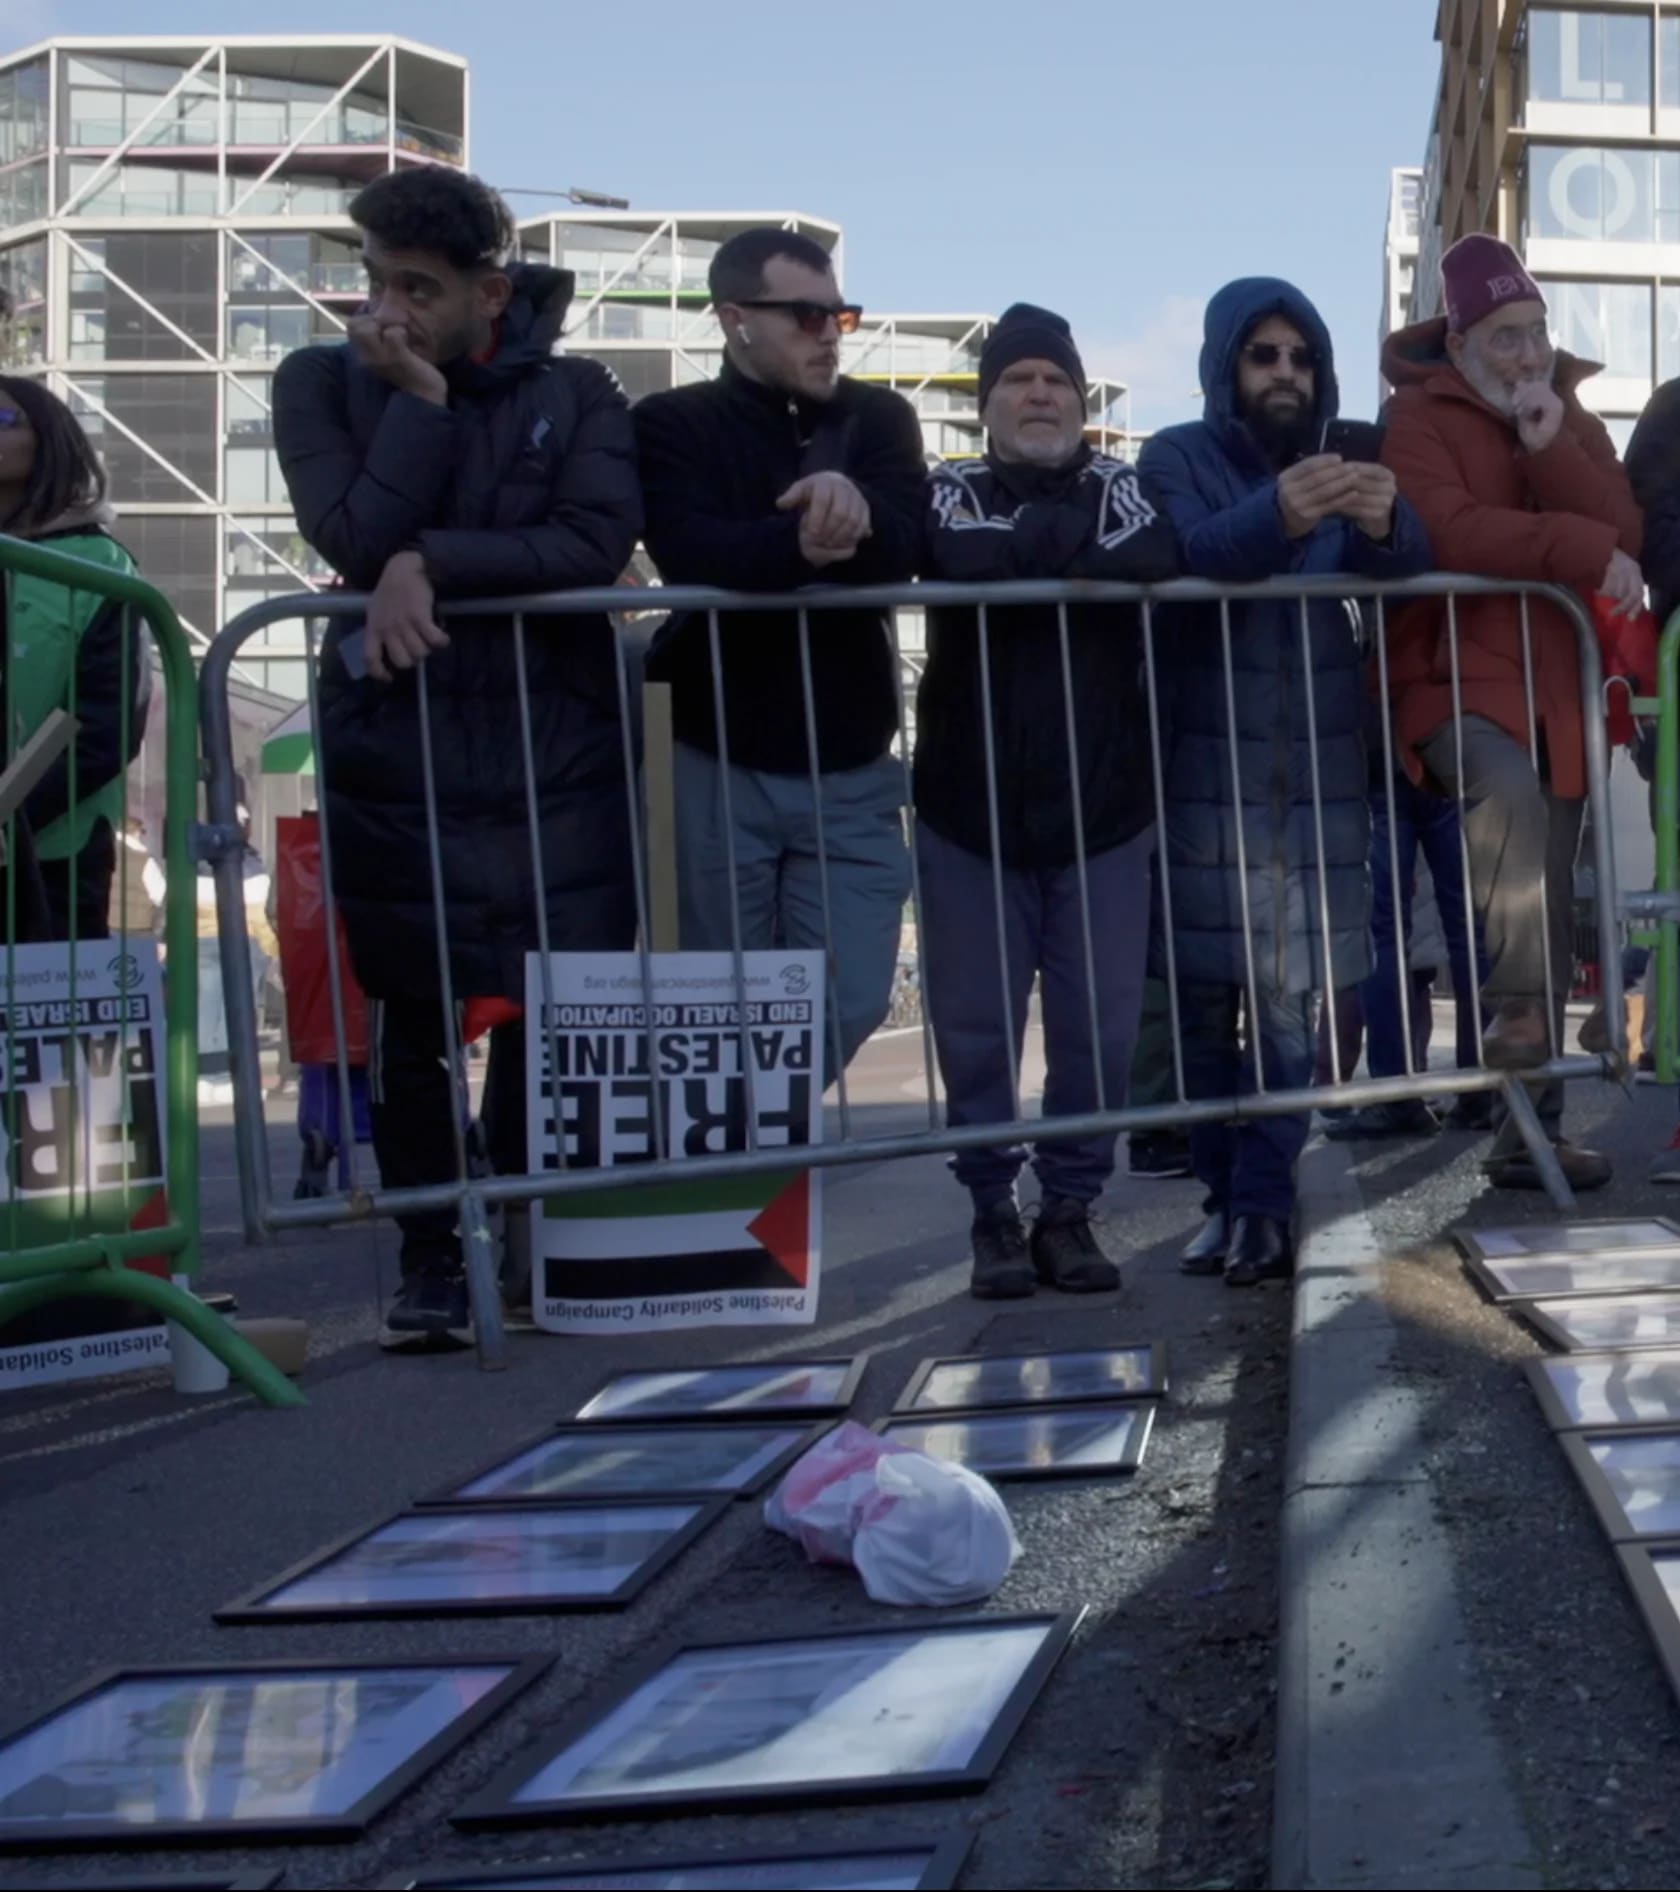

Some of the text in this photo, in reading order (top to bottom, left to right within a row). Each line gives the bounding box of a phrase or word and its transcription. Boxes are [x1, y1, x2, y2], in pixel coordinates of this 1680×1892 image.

[583, 972, 771, 991] wwwpalestinecamaign.org
[98, 996, 146, 1019] END
[546, 1001, 809, 1027] END ISRAELI OCCUPATIO
[0, 1028, 155, 1084] PALE
[541, 1029, 812, 1077] PALESTINE
[540, 1074, 812, 1169] FREE
[544, 1294, 806, 1321] Palestine Solidarity Campaign
